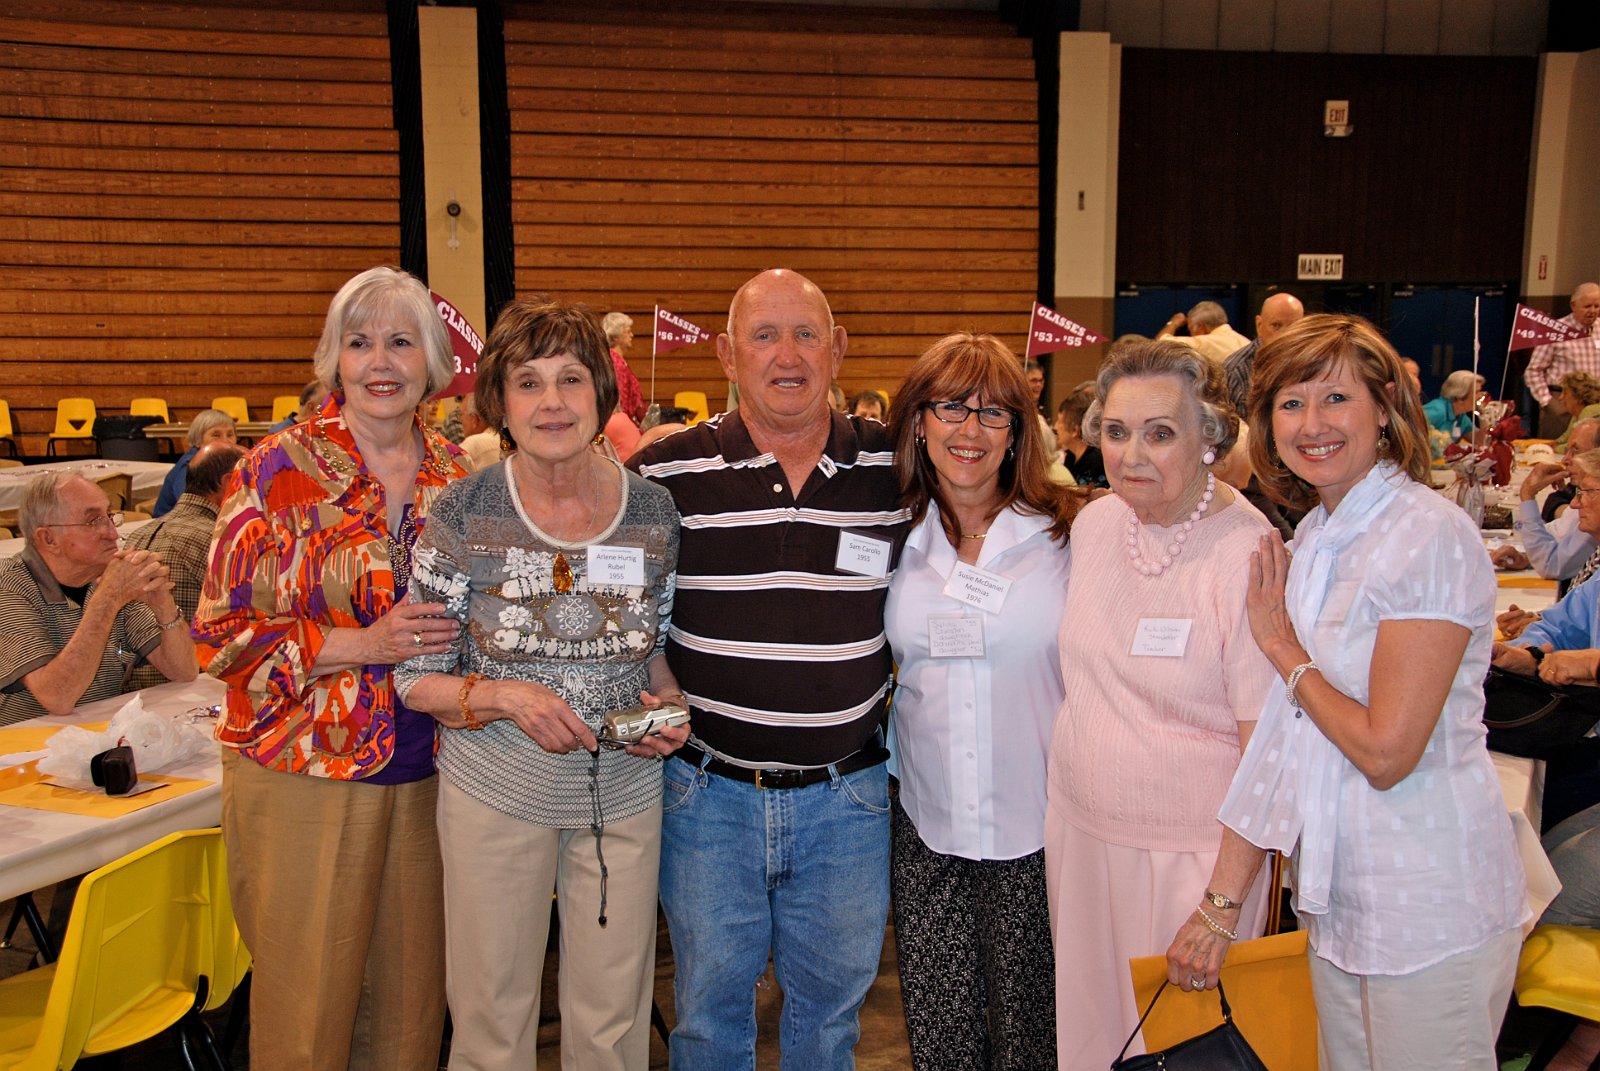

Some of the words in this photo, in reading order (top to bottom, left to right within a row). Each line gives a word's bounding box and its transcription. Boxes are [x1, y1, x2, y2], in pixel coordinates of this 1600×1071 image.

[1330, 108, 1345, 122] EXIT
[1299, 259, 1321, 275] MAIN
[1325, 258, 1342, 275] EXIT
[659, 310, 700, 335] CLASSES
[1037, 306, 1086, 337] CLASSES
[1086, 334, 1097, 343] of
[1520, 308, 1568, 333] CLASSES
[658, 331, 673, 341] '56
[682, 334, 697, 344] '57
[1034, 331, 1053, 343] '53
[1063, 335, 1082, 347] '55
[1517, 329, 1535, 338] '49
[1546, 332, 1565, 342] '52
[849, 542, 861, 550] Sam
[618, 554, 637, 563] Hurtig
[857, 553, 871, 562] 1955
[608, 562, 626, 570] Rubel
[609, 572, 625, 580] 1955
[958, 570, 974, 582] Susie
[975, 577, 1004, 593] McDaniel
[965, 583, 990, 597] Mathias
[966, 593, 982, 604] 1976
